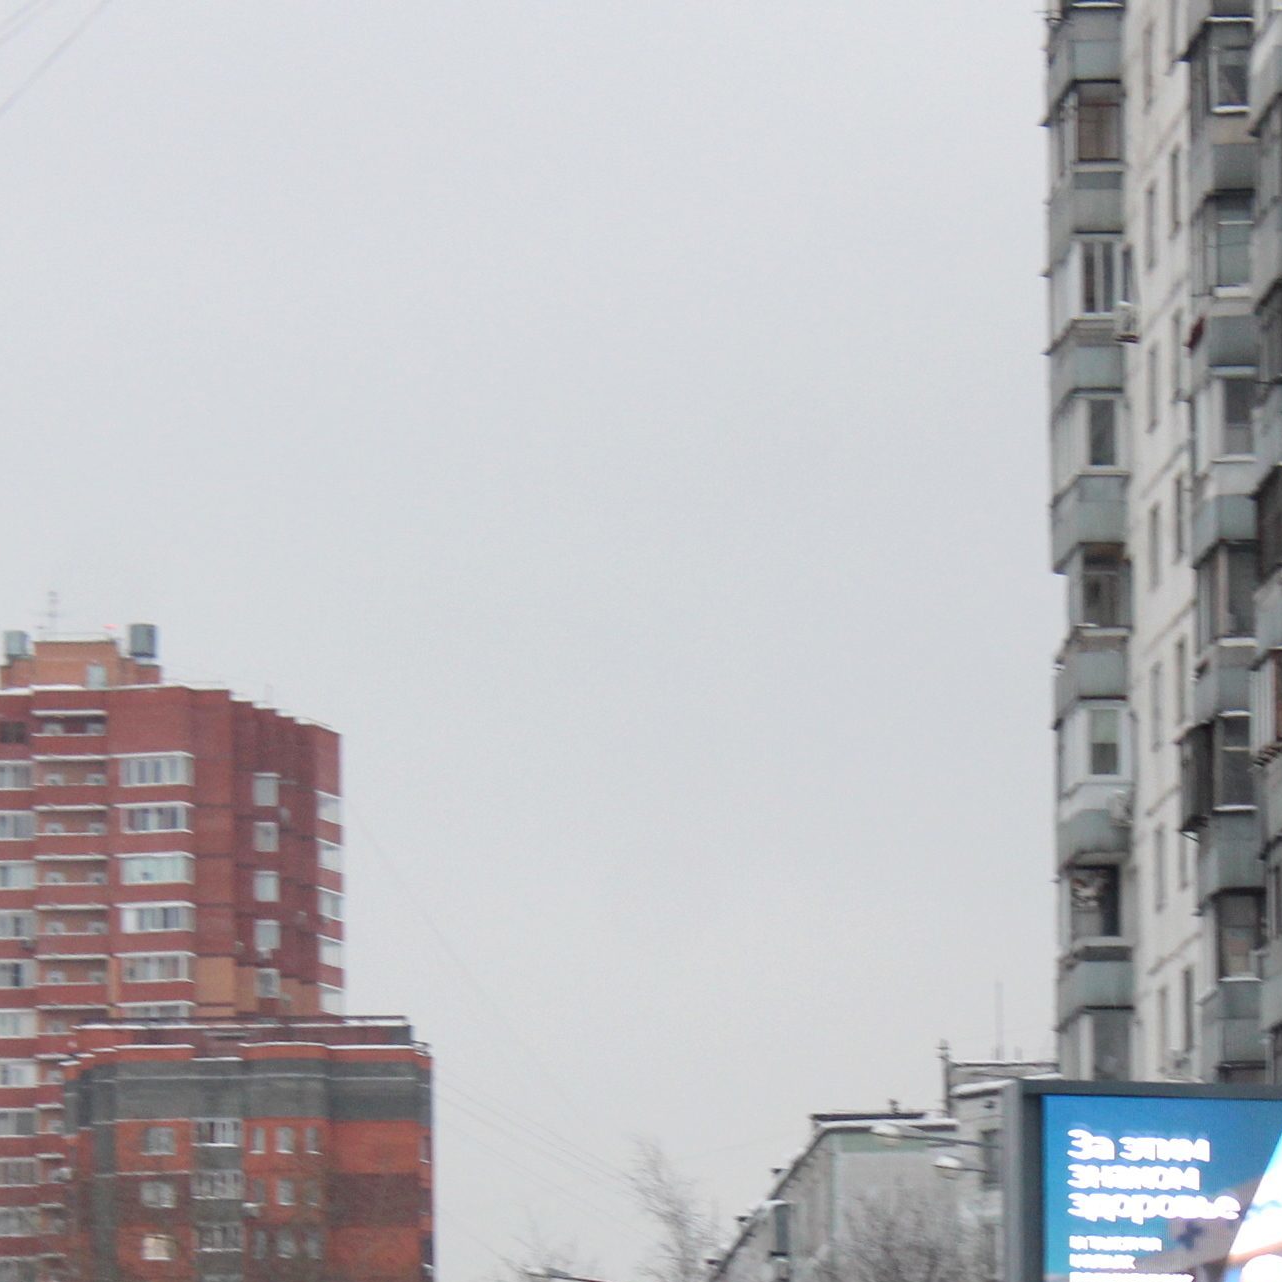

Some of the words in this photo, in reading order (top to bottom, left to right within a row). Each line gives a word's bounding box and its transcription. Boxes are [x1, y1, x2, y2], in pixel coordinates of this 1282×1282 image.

[1067, 1129, 1115, 1160] За
[1119, 1137, 1210, 1162] этим
[1067, 1164, 1200, 1190] знаком
[1067, 1193, 1241, 1224] здоровье
